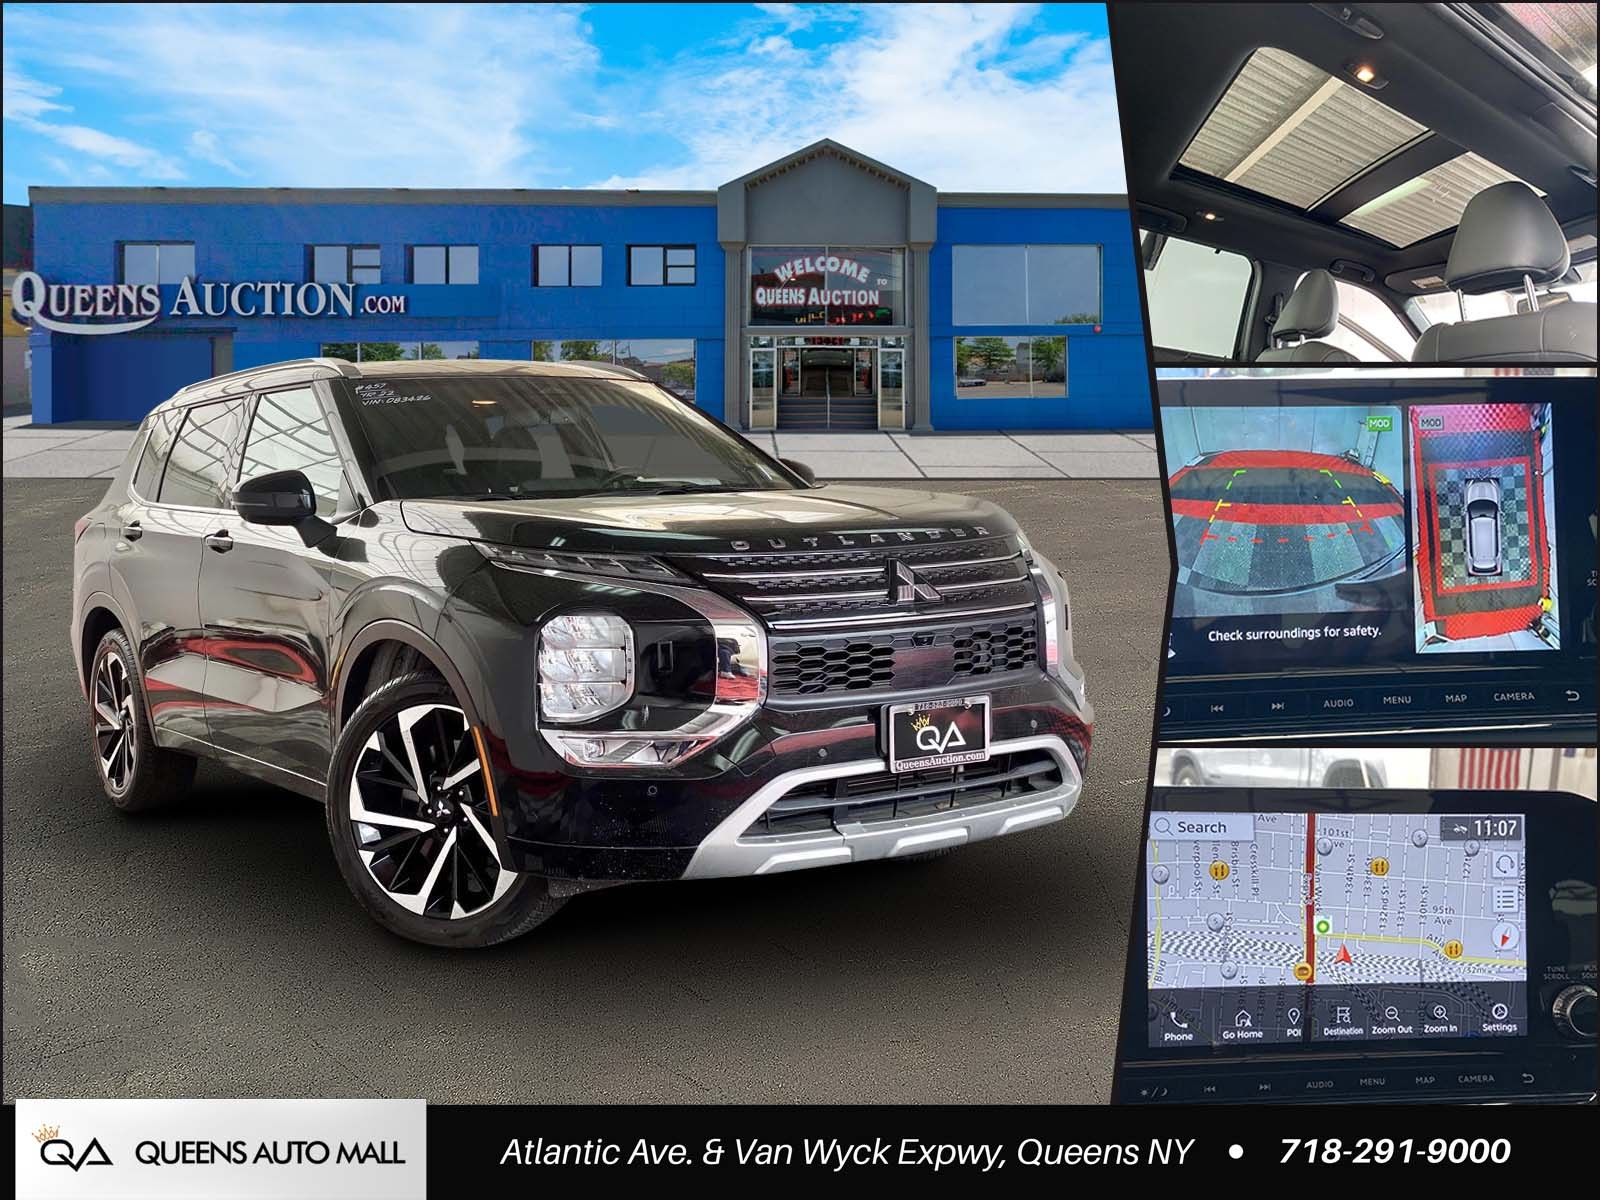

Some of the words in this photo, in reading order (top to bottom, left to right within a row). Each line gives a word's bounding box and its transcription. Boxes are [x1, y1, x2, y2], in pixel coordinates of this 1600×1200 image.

[773, 255, 871, 283] WELCOME
[11, 271, 162, 335] QUEENS
[755, 286, 805, 306] QUEENS
[808, 287, 879, 305] AUCTION
[1369, 419, 1390, 428] MOD
[1421, 418, 1442, 427] MOD
[730, 525, 990, 551] OUTLANDER
[1208, 629, 1243, 642] Check
[1246, 626, 1321, 641] surroundings
[1323, 625, 1340, 638] for
[1343, 624, 1382, 639] safety.
[1323, 698, 1354, 708] AUDIO
[1383, 695, 1412, 705] MENU
[1445, 694, 1468, 703] MAP
[1493, 691, 1536, 702] CAMERA
[916, 721, 967, 754] QA
[896, 751, 985, 771] QueensAuction.com
[1177, 821, 1227, 833] Search
[1474, 819, 1517, 836] 11:07
[1192, 840, 1202, 878] verpool
[1231, 840, 1240, 876] Brisbin
[1250, 843, 1259, 884] Cresskill
[1432, 905, 1455, 915] 95th
[1434, 917, 1453, 926] Ave
[1426, 933, 1445, 948] Atla
[1222, 1030, 1235, 1039] Go
[1237, 1030, 1264, 1039] Home
[1286, 1028, 1301, 1037] POI
[1323, 1026, 1364, 1036] Destination
[1371, 1026, 1396, 1035] Zoom
[1397, 1025, 1413, 1034] Out
[1423, 1024, 1448, 1033] Zoom
[1449, 1023, 1458, 1032] In
[1482, 1022, 1518, 1033] Settings
[1164, 1032, 1194, 1041] Phone
[1306, 1080, 1334, 1089] AUDIO
[1359, 1077, 1386, 1087] MENU
[1415, 1076, 1436, 1085] MAP
[1457, 1074, 1495, 1084] CAMERA
